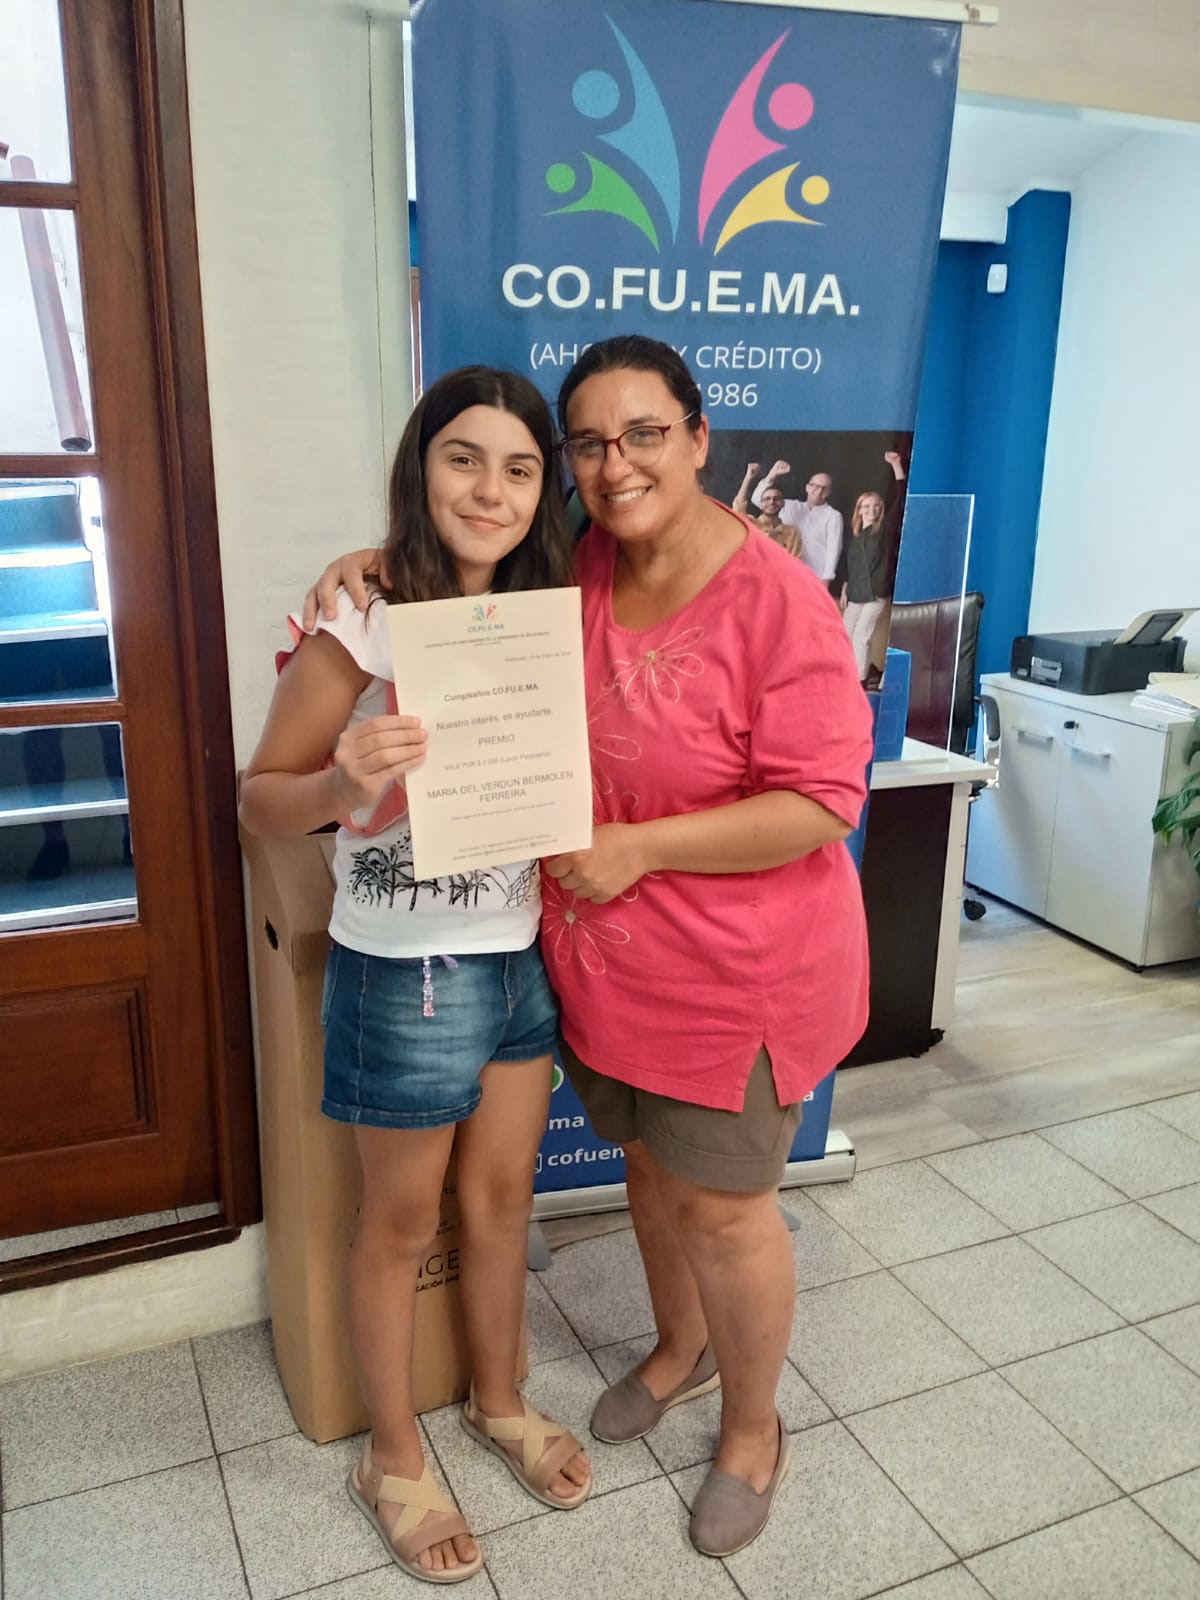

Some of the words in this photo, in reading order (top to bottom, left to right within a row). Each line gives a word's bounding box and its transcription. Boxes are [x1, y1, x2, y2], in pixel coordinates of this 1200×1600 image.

[501, 263, 861, 316] CO.FU.E.MA.
[695, 341, 823, 375] CRÉDITO)
[697, 382, 759, 408] 986
[444, 689, 490, 702] Cumpleaños
[436, 718, 469, 731] Nuestro
[478, 734, 515, 747] PREMIO
[427, 786, 458, 799] MARIA
[460, 783, 479, 795] DEL
[480, 778, 521, 792] VERDUN
[522, 770, 574, 786] BERMOLEN
[479, 789, 527, 803] FERREIRA
